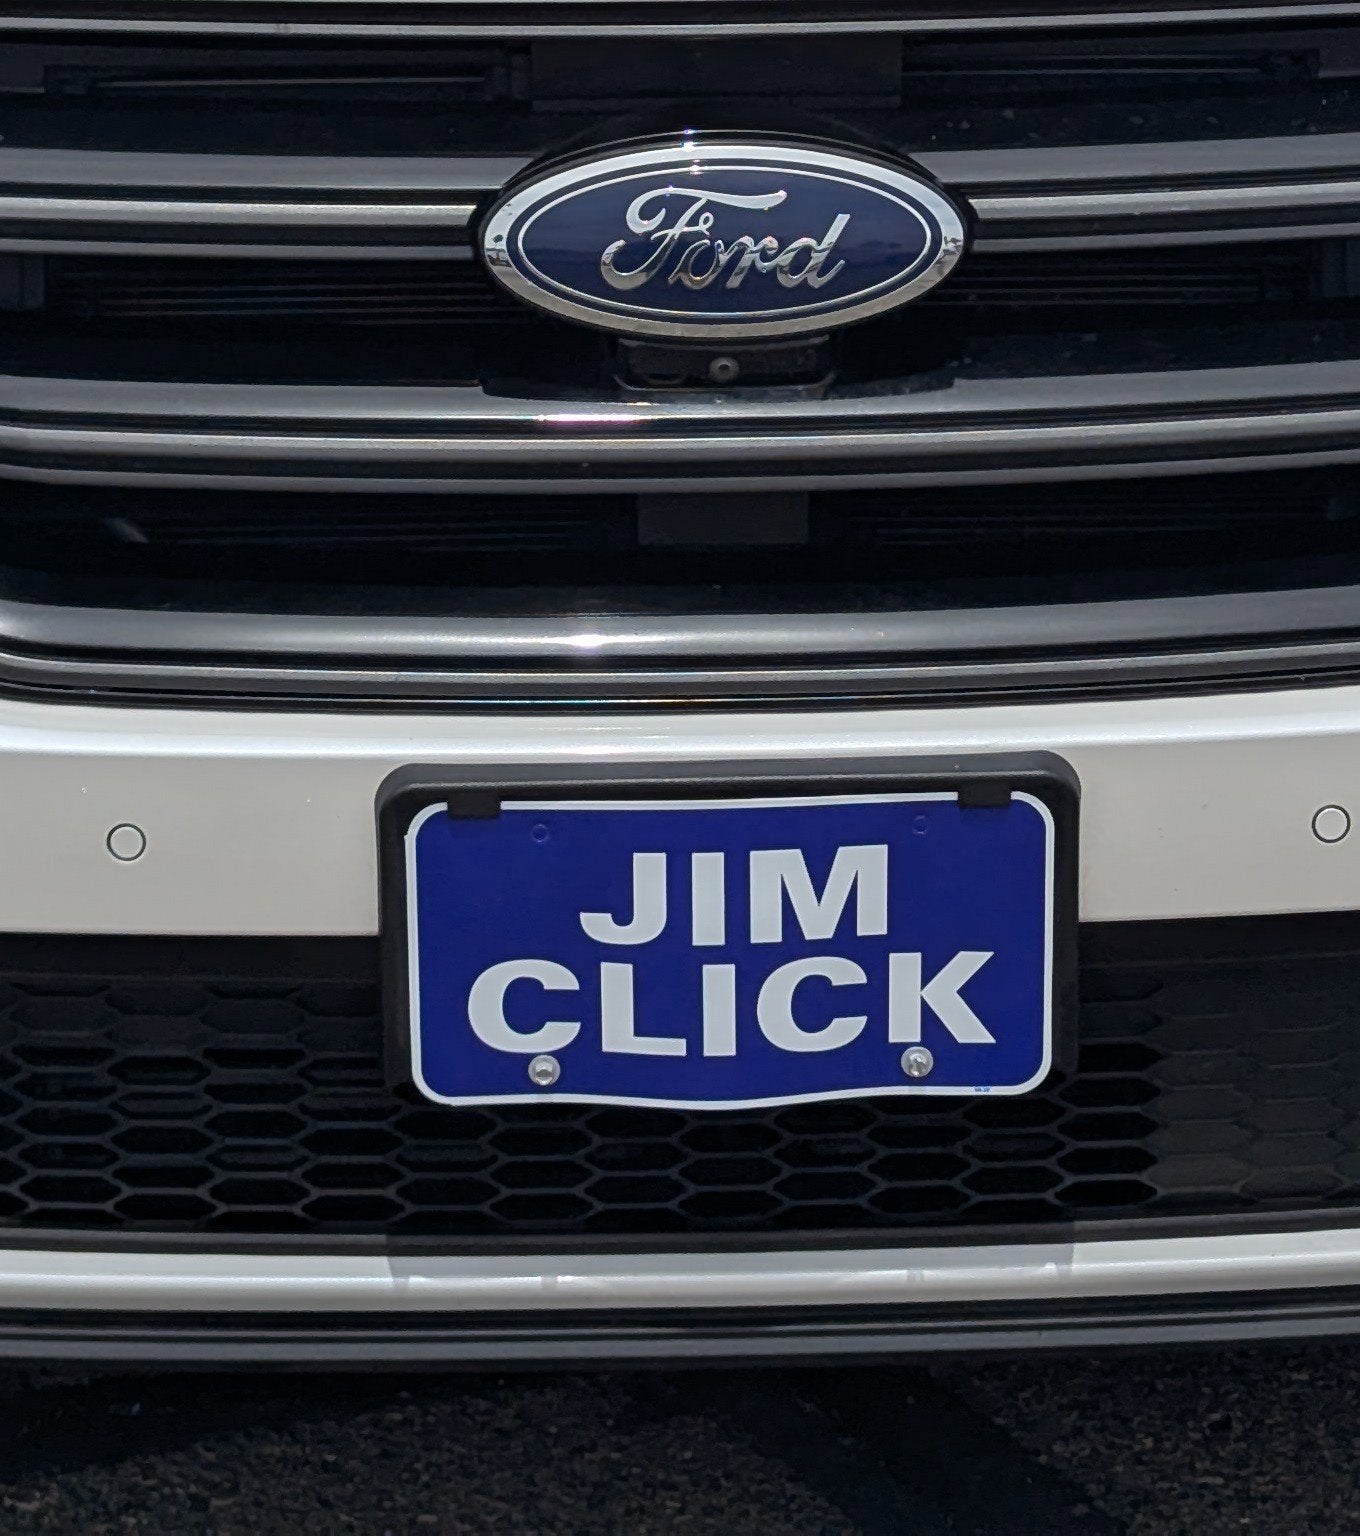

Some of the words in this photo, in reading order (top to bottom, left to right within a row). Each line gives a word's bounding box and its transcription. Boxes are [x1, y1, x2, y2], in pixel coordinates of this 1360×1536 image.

[600, 186, 851, 292] Ford
[579, 844, 889, 947] JIM
[467, 950, 997, 1058] CLICK
